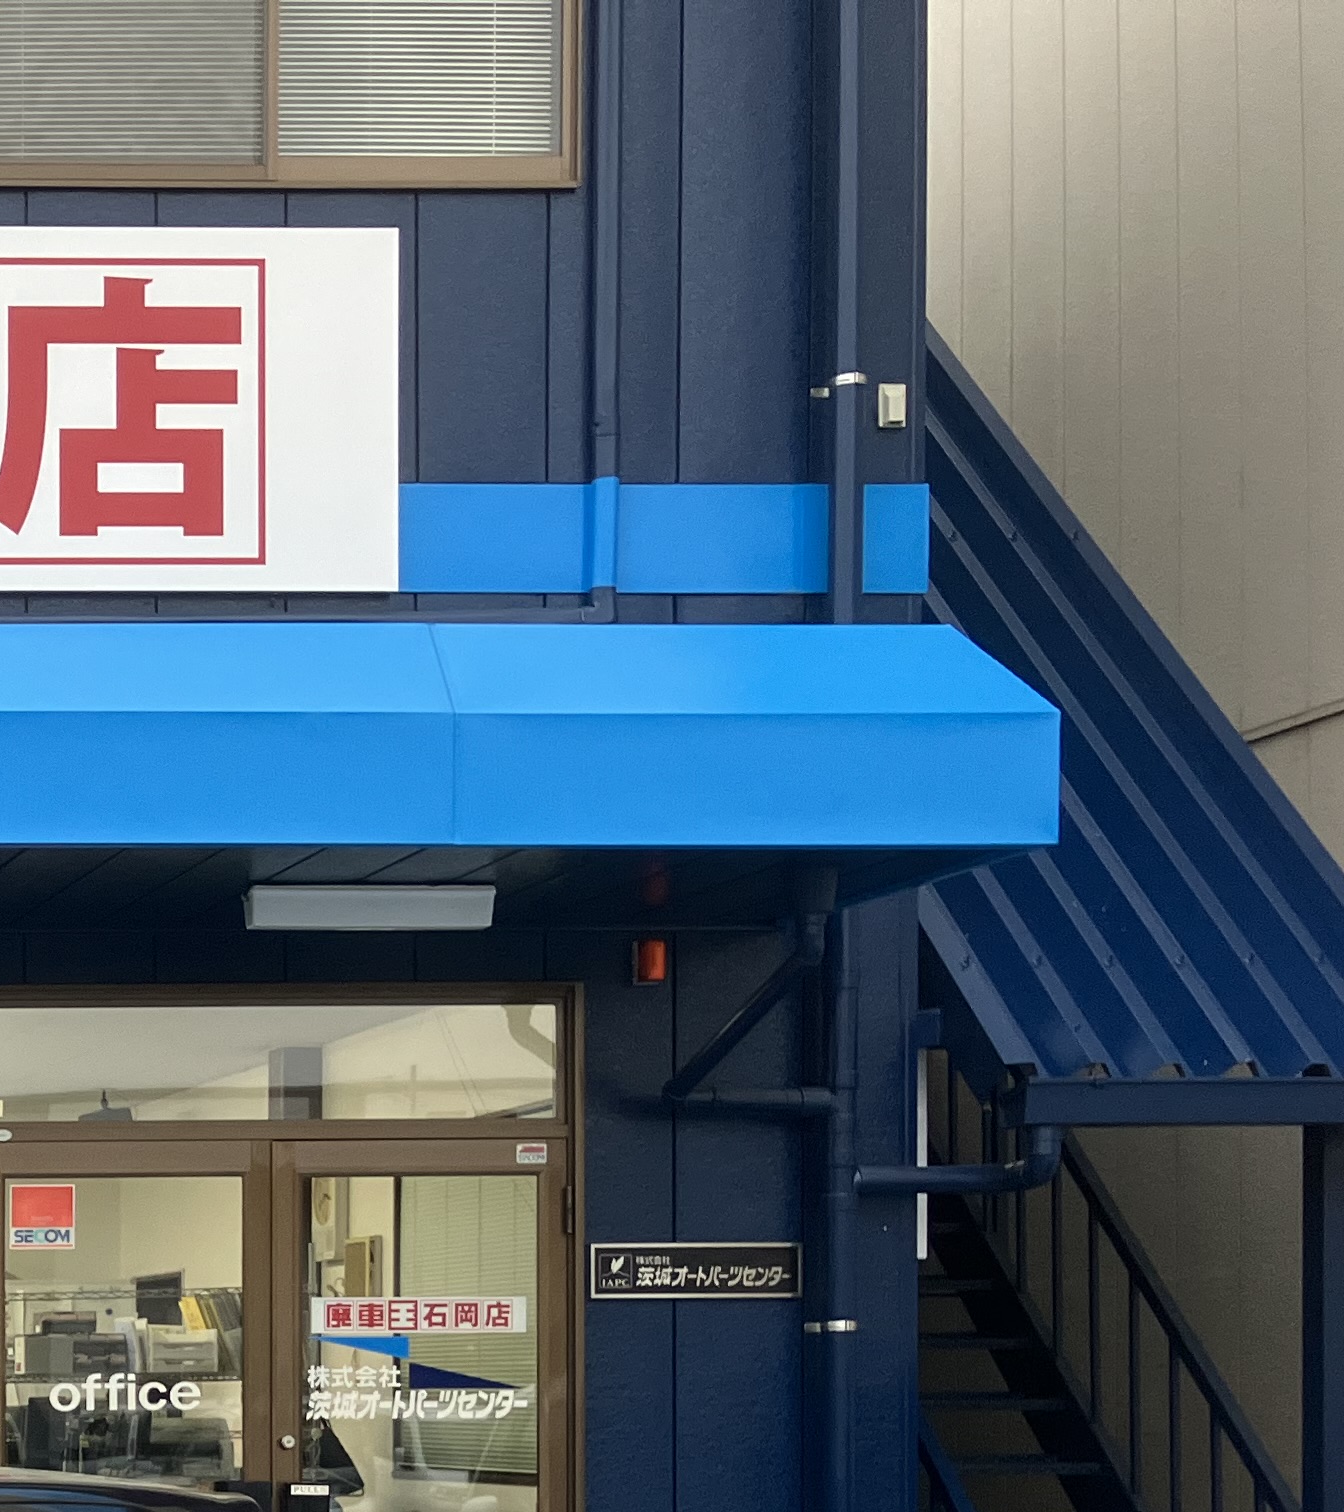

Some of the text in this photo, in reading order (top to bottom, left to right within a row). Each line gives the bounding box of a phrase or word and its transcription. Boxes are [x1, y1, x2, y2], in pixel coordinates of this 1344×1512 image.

[14, 1229, 70, 1243] SECOM
[635, 1256, 671, 1266] 株式会社
[635, 1265, 791, 1288] 茨城オートパーツセンター
[326, 1300, 513, 1330] 廃車王石岡店
[307, 1364, 402, 1389] 株式会社
[49, 1372, 202, 1412] office
[305, 1389, 529, 1421] 茨城オートパーツセンター
